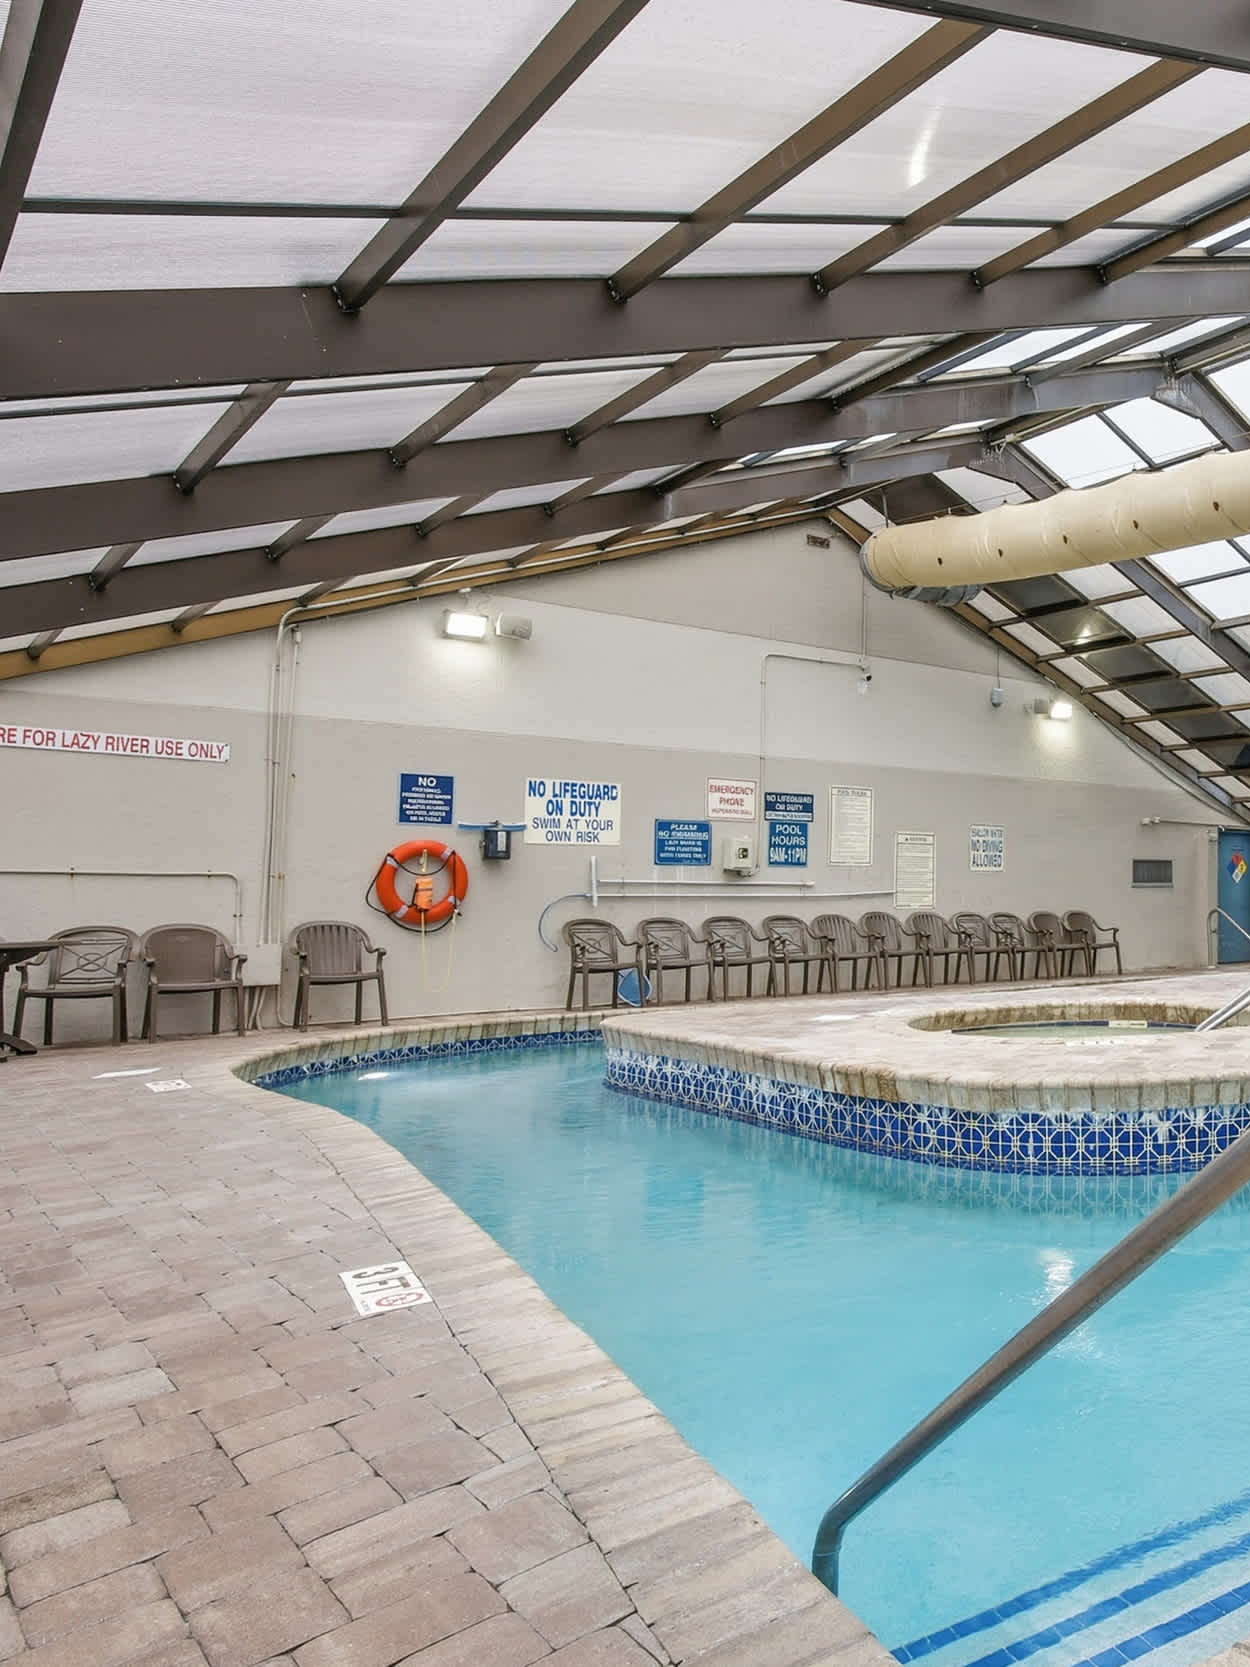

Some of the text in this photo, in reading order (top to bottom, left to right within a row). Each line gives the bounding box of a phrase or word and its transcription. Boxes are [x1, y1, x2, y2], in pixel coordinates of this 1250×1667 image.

[22, 729, 56, 747] FOR
[61, 732, 100, 751] LAZY
[105, 735, 150, 754] RIVER
[155, 739, 184, 756] USE
[188, 742, 225, 759] ONLY
[418, 777, 437, 787] NO
[528, 780, 618, 801] NO LIFEGUARD
[546, 799, 601, 817] ON DUTY
[532, 817, 614, 831] SWIM AT YOUR
[776, 824, 802, 834] POOL
[545, 830, 600, 842] OWN RISK
[771, 836, 806, 846] HOURS
[769, 847, 807, 863] 9AM-11PM
[352, 1266, 411, 1295] 3 FT
